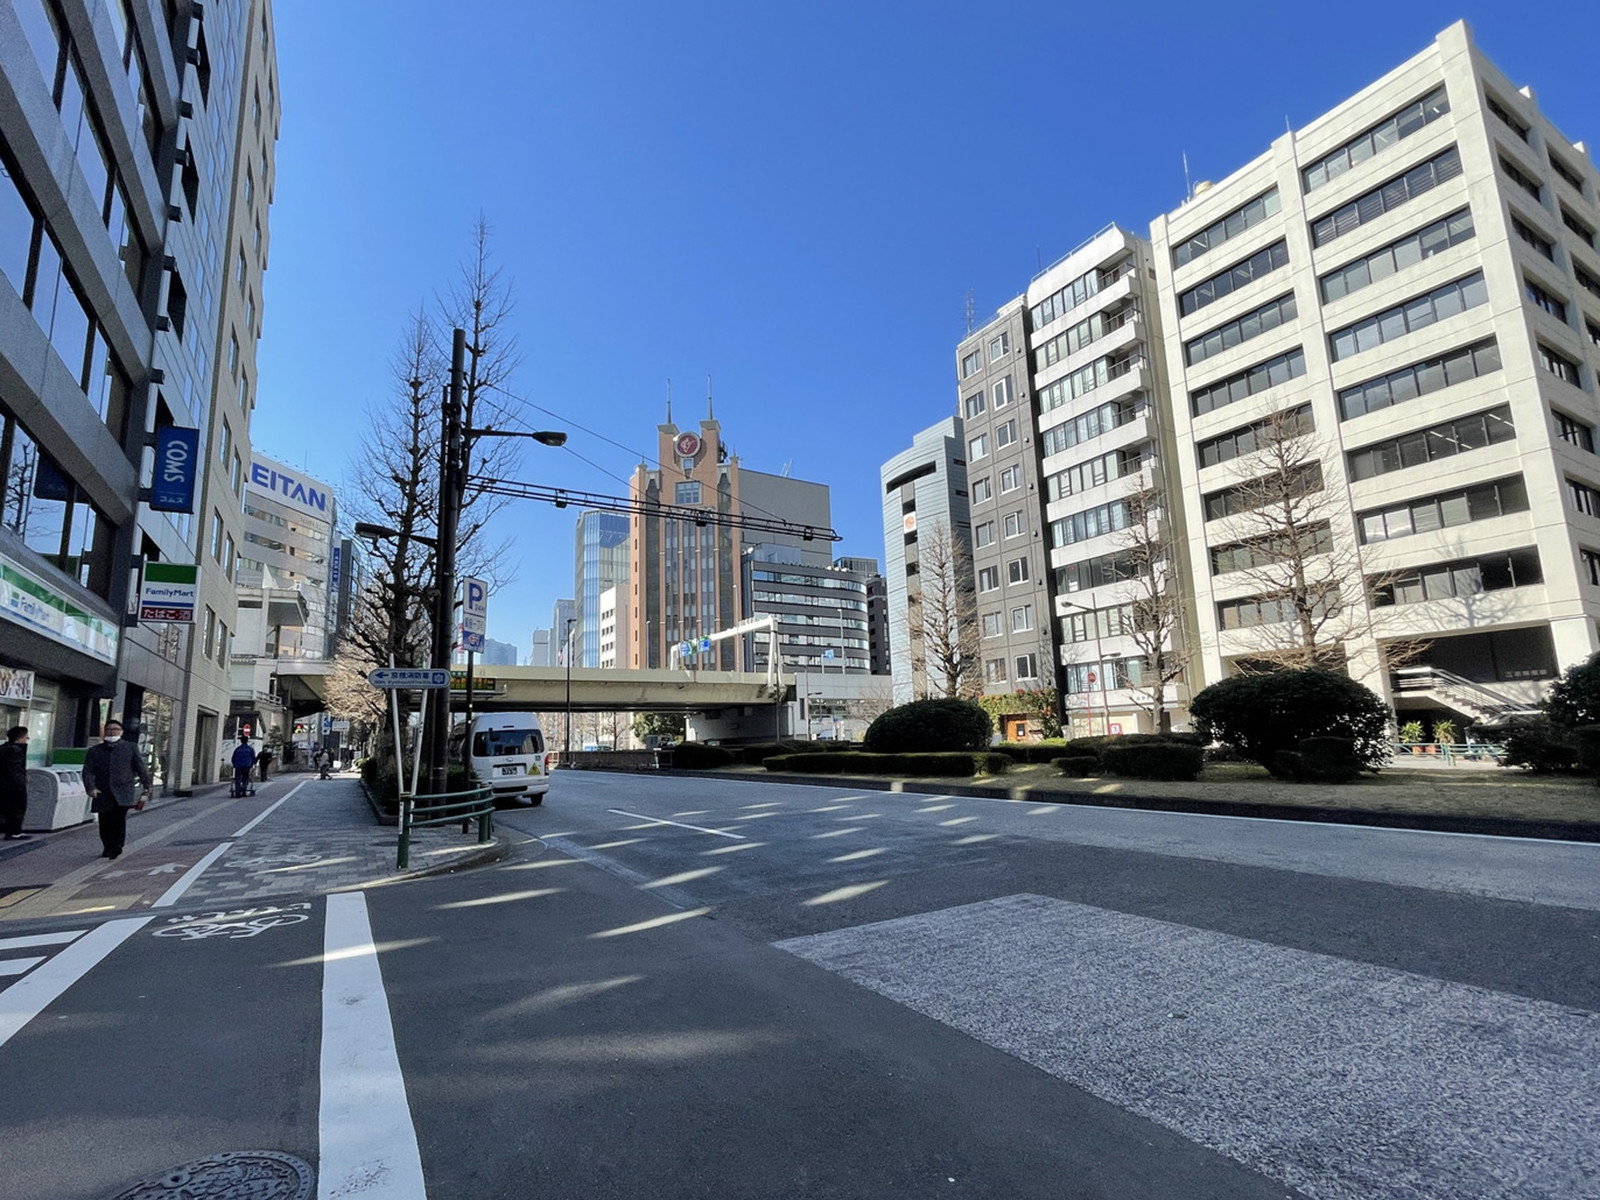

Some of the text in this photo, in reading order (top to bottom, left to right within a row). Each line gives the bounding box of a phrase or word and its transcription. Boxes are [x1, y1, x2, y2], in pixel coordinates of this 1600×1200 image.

[164, 440, 189, 483] COMS
[249, 461, 326, 512] EITAN
[145, 587, 194, 598] FamilyMart
[468, 582, 483, 610] P
